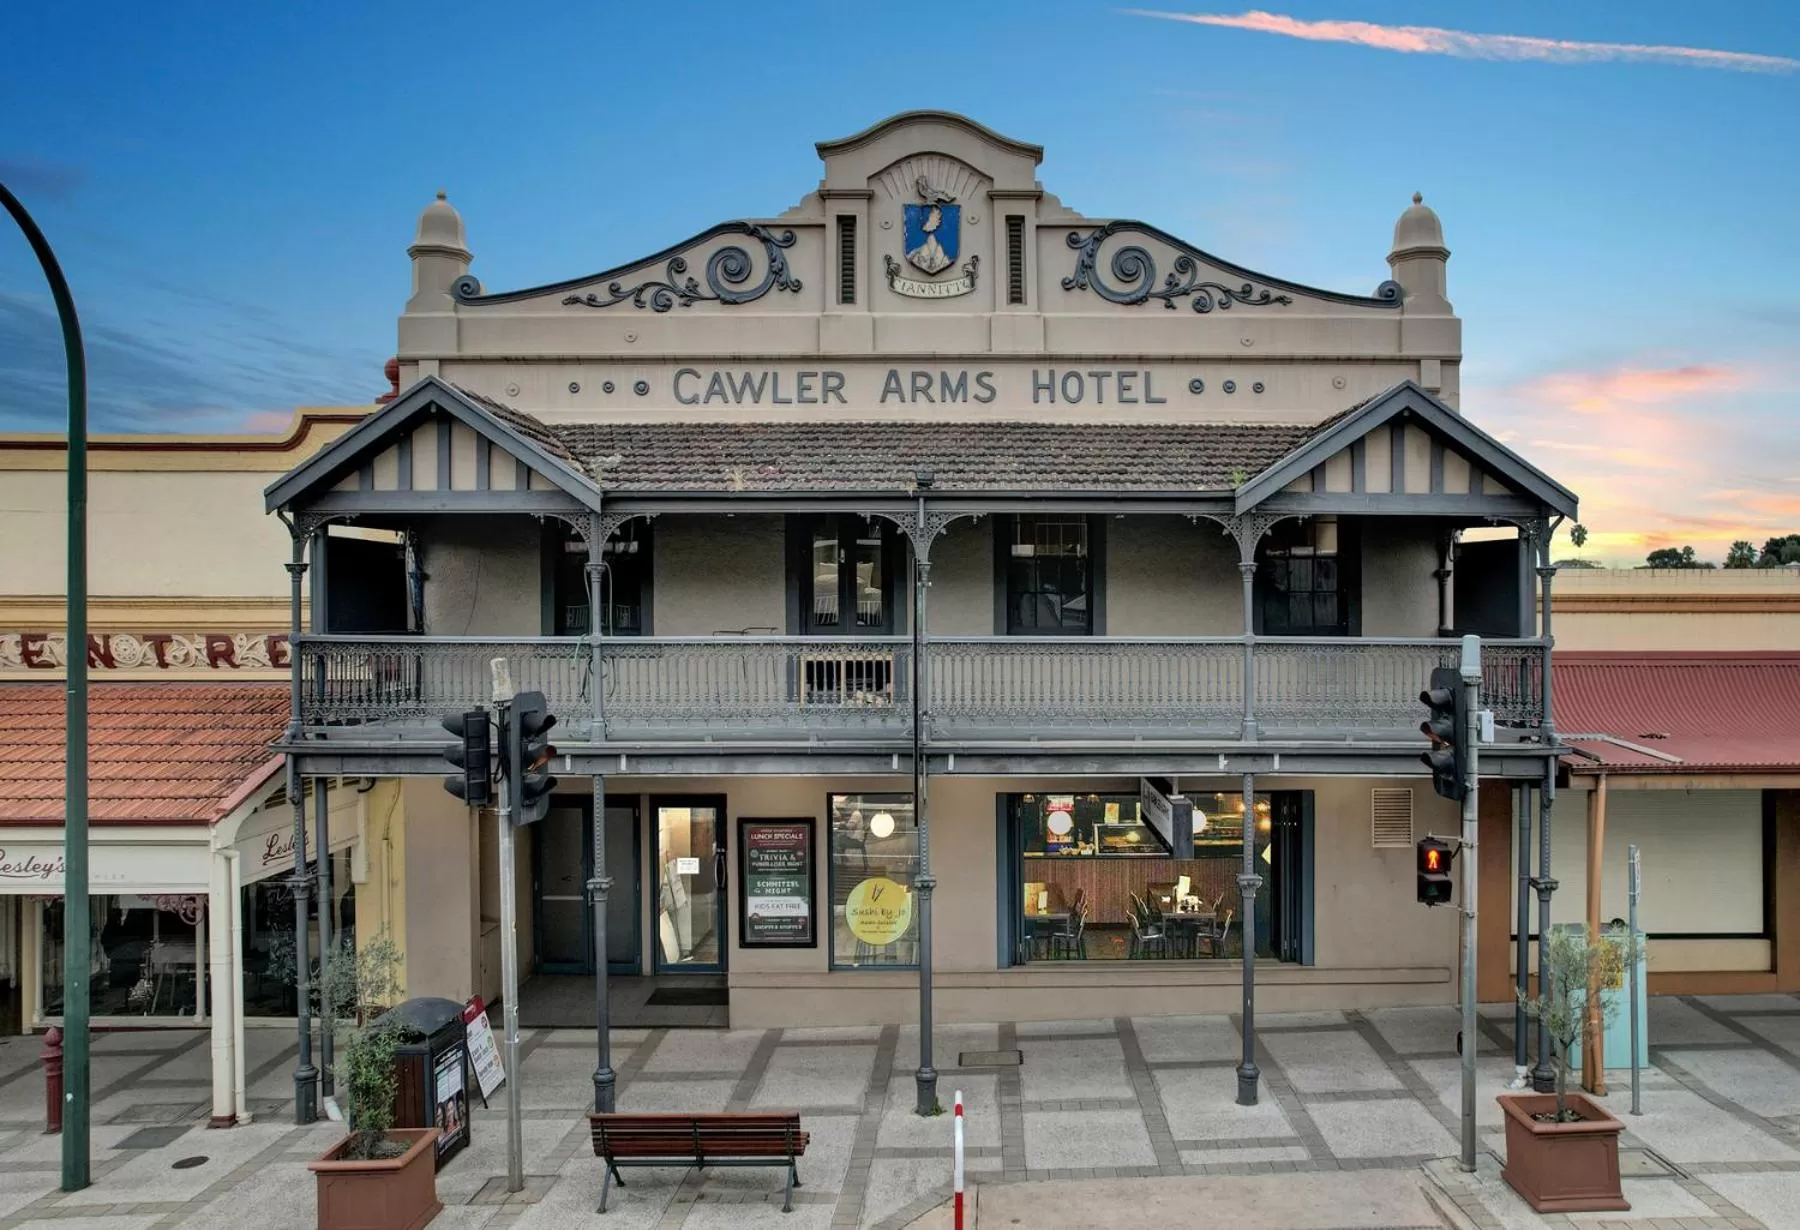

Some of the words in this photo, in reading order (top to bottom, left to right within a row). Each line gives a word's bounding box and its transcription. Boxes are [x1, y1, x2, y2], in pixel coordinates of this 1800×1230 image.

[673, 368, 848, 404] GAWLER
[879, 369, 997, 404] ARMS
[1032, 368, 1168, 404] HOTEL
